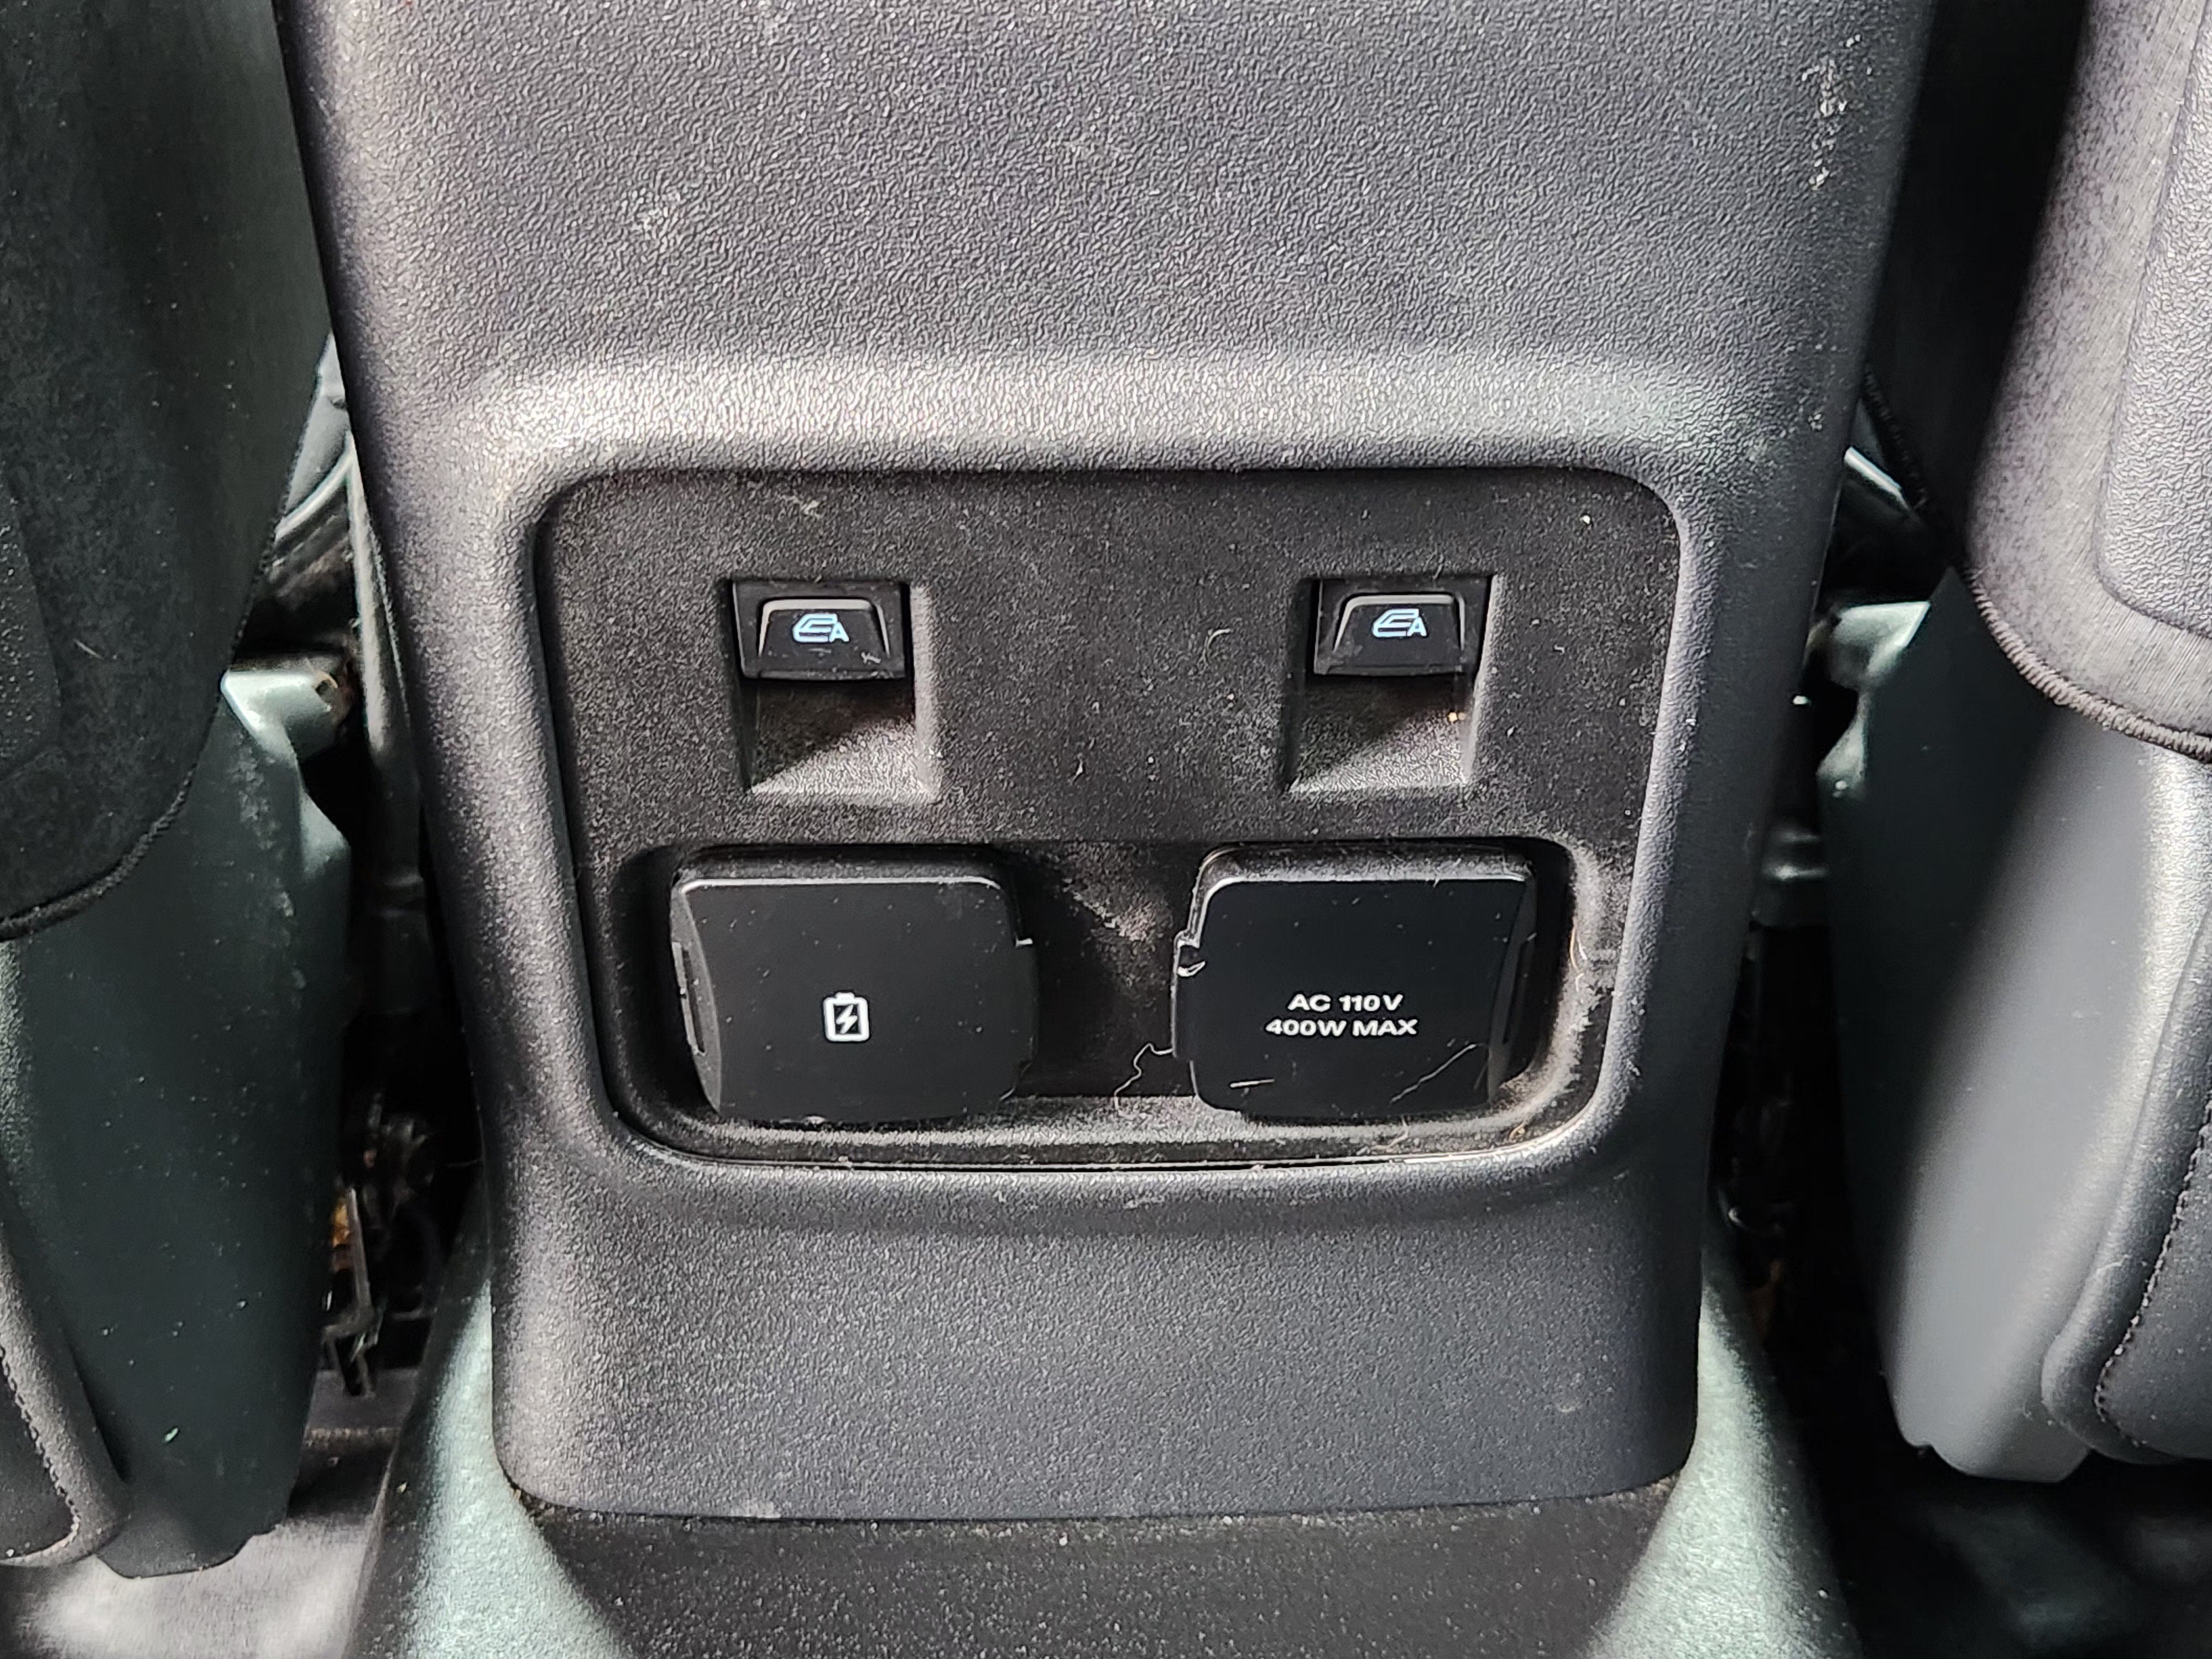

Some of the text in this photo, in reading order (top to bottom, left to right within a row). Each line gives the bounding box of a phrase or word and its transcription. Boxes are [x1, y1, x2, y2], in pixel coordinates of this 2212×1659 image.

[1287, 994, 1404, 1013] AC 110V
[1265, 1019, 1418, 1037] 400W MAX
